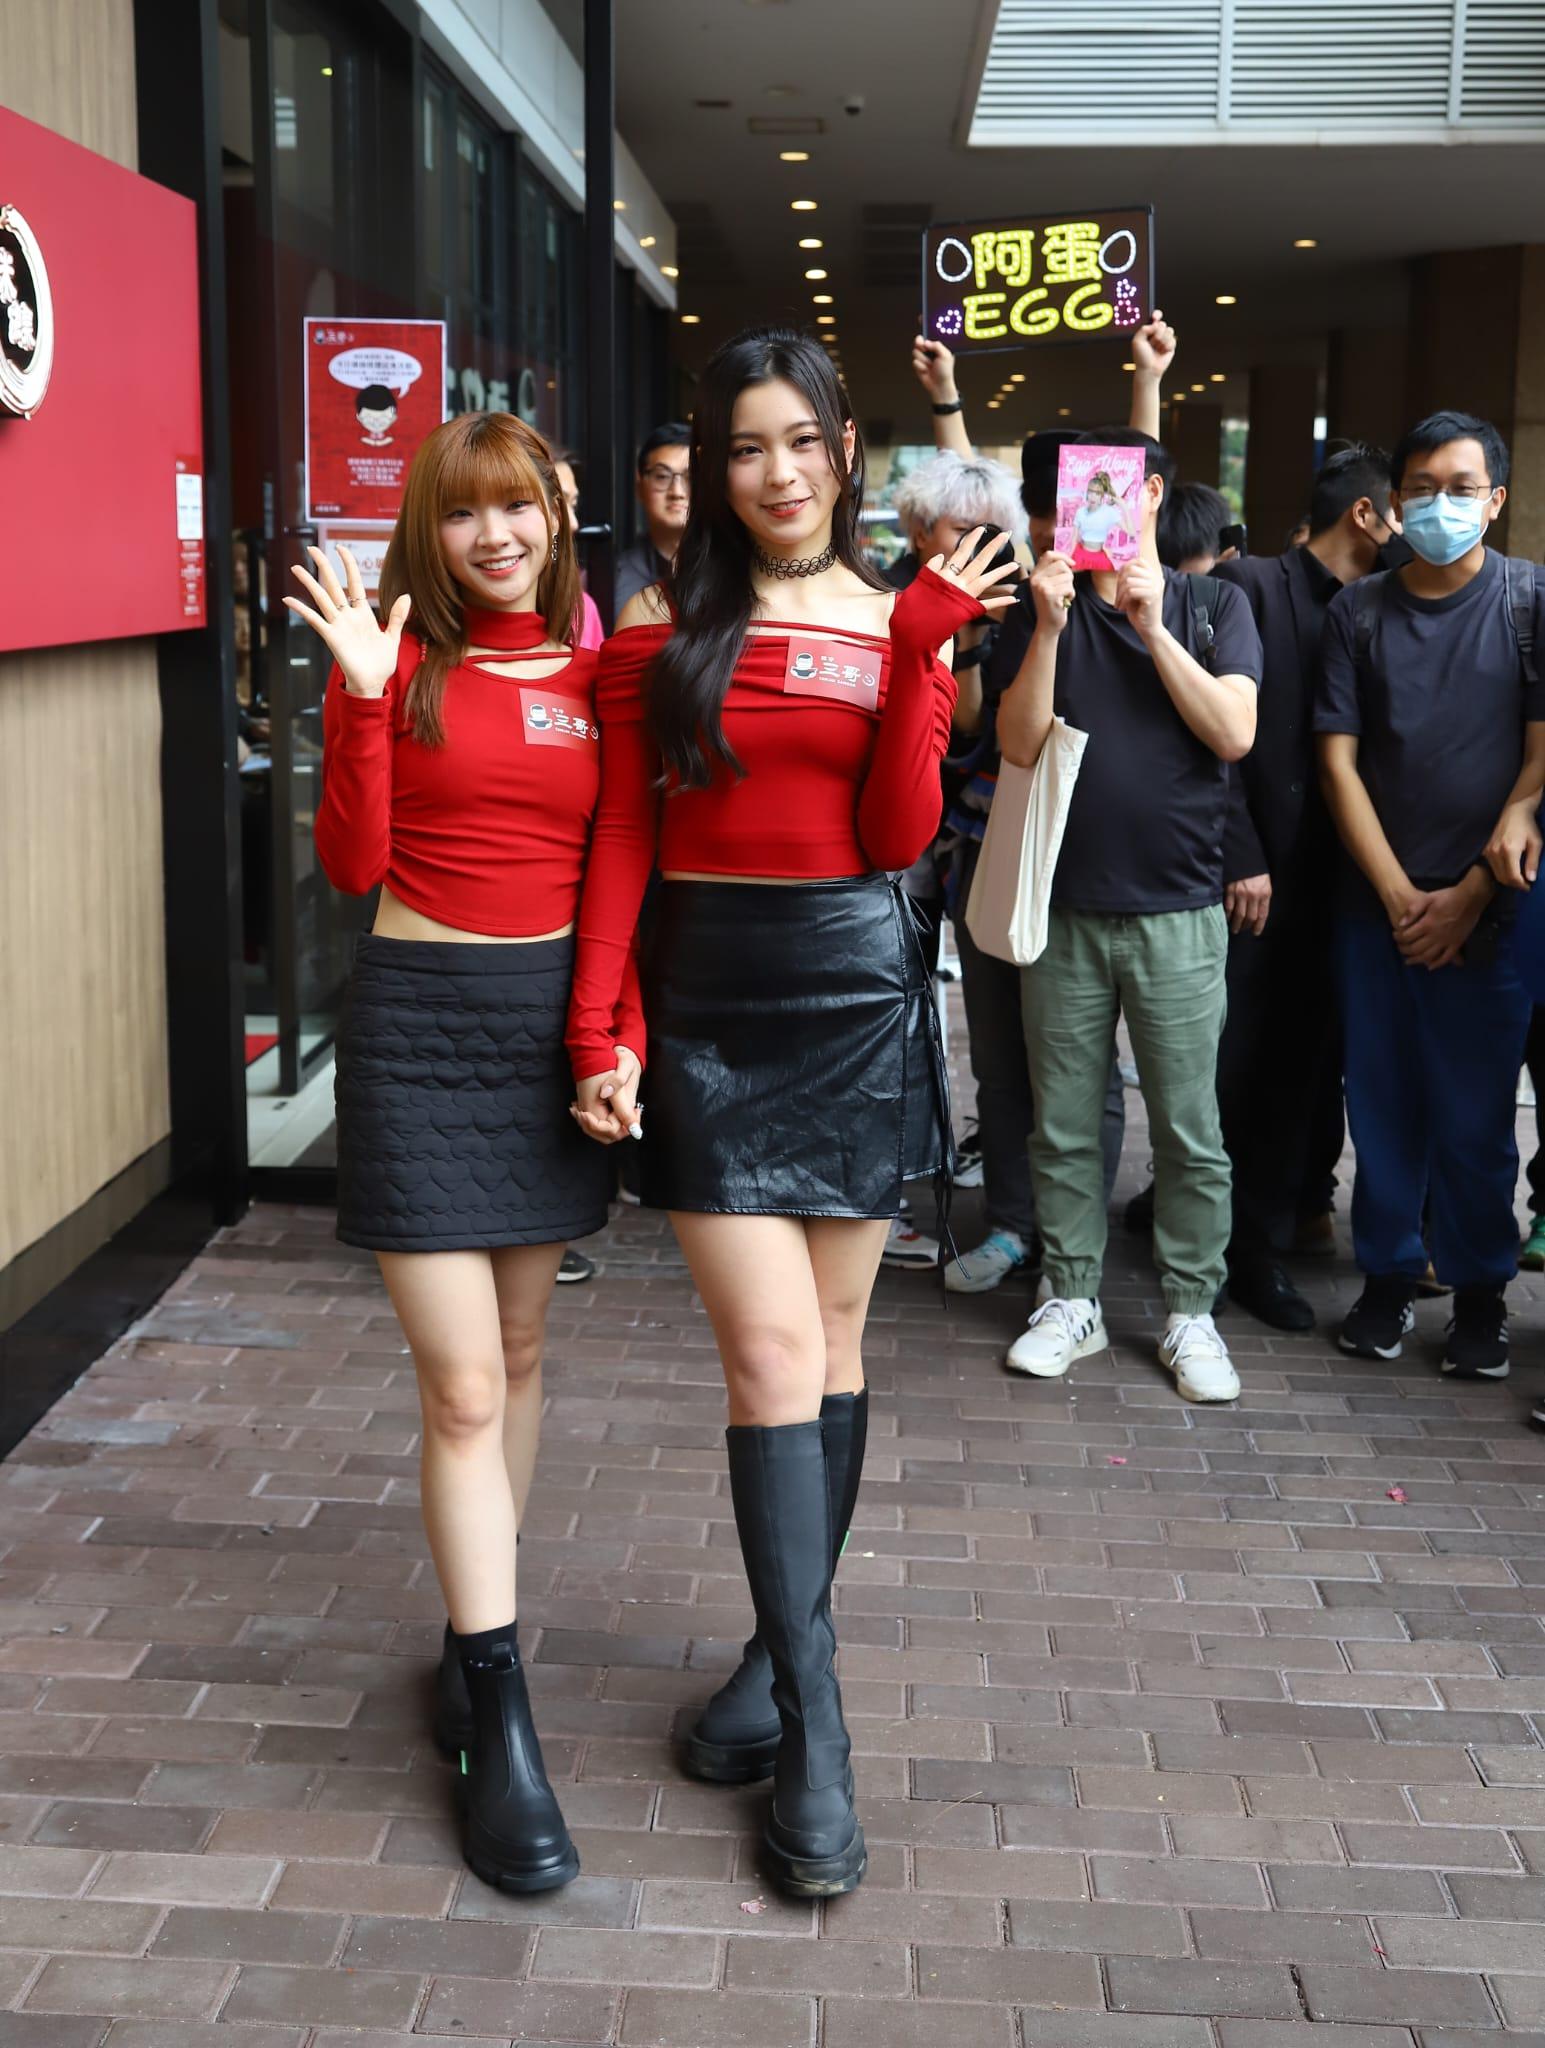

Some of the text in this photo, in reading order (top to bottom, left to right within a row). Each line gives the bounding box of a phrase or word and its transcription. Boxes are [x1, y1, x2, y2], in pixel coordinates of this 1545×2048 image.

[971, 222, 1103, 289] 阿蛋
[963, 283, 1114, 340] EGG
[818, 662, 861, 682] 三哥
[554, 714, 588, 735] 三哥
